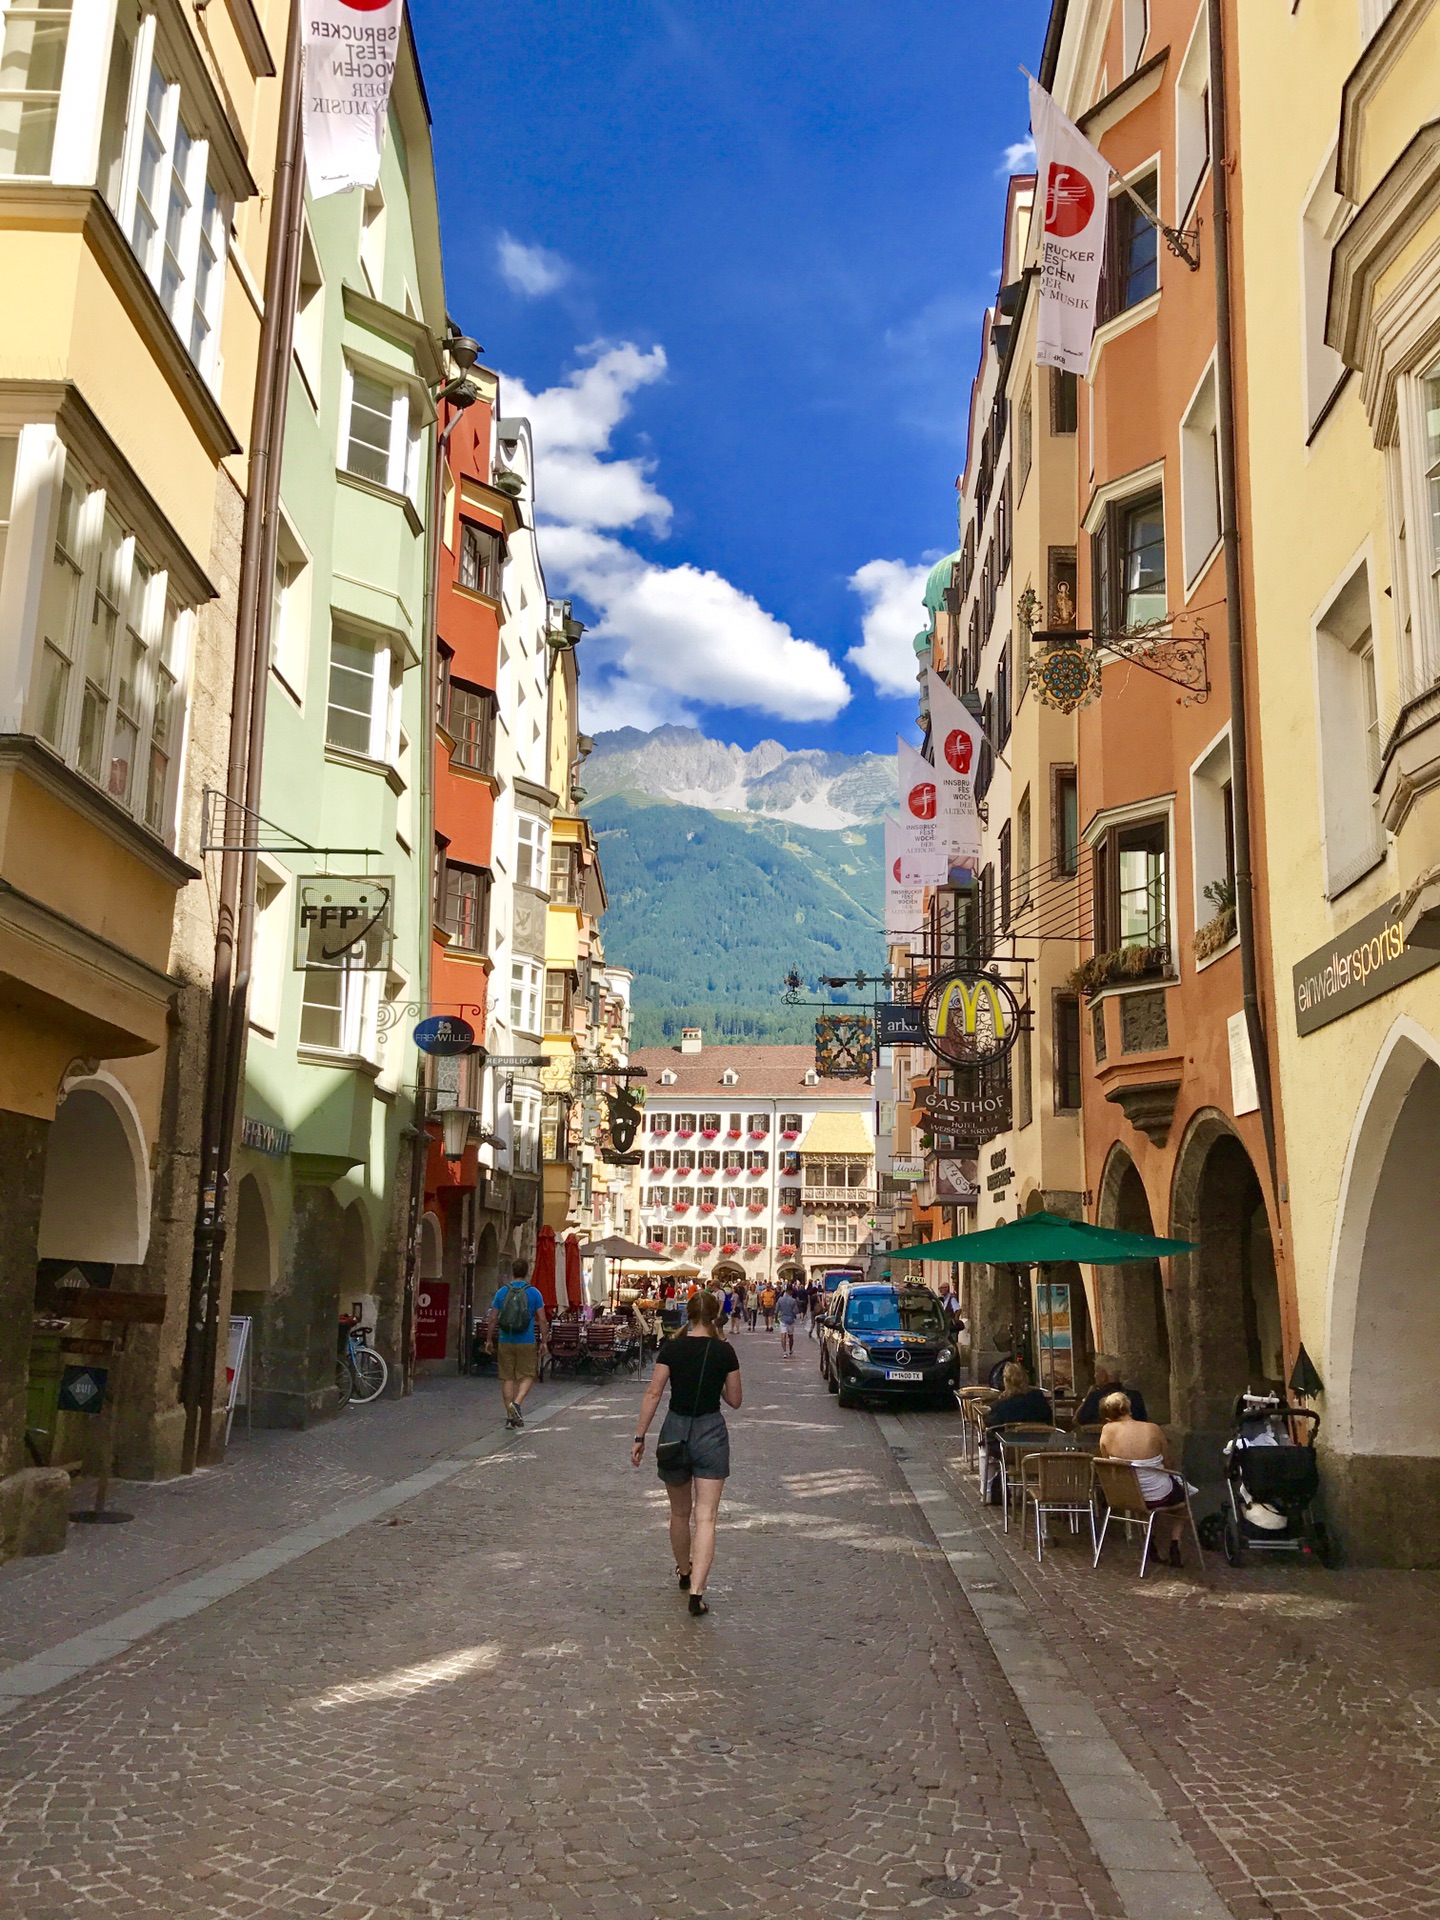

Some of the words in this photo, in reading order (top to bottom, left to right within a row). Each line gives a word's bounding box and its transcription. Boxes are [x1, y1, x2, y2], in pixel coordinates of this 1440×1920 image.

[1042, 252, 1066, 267] EST
[1049, 289, 1091, 309] MUSIK
[301, 906, 358, 929] FFP
[415, 1033, 471, 1042] FREYWILLE
[486, 1057, 533, 1065] REPUBLICA
[925, 1094, 1004, 1113] GASTHOF
[930, 1123, 967, 1135] WEISSES
[970, 1126, 999, 1135] KREUZ
[951, 1121, 978, 1129] HOTEL
